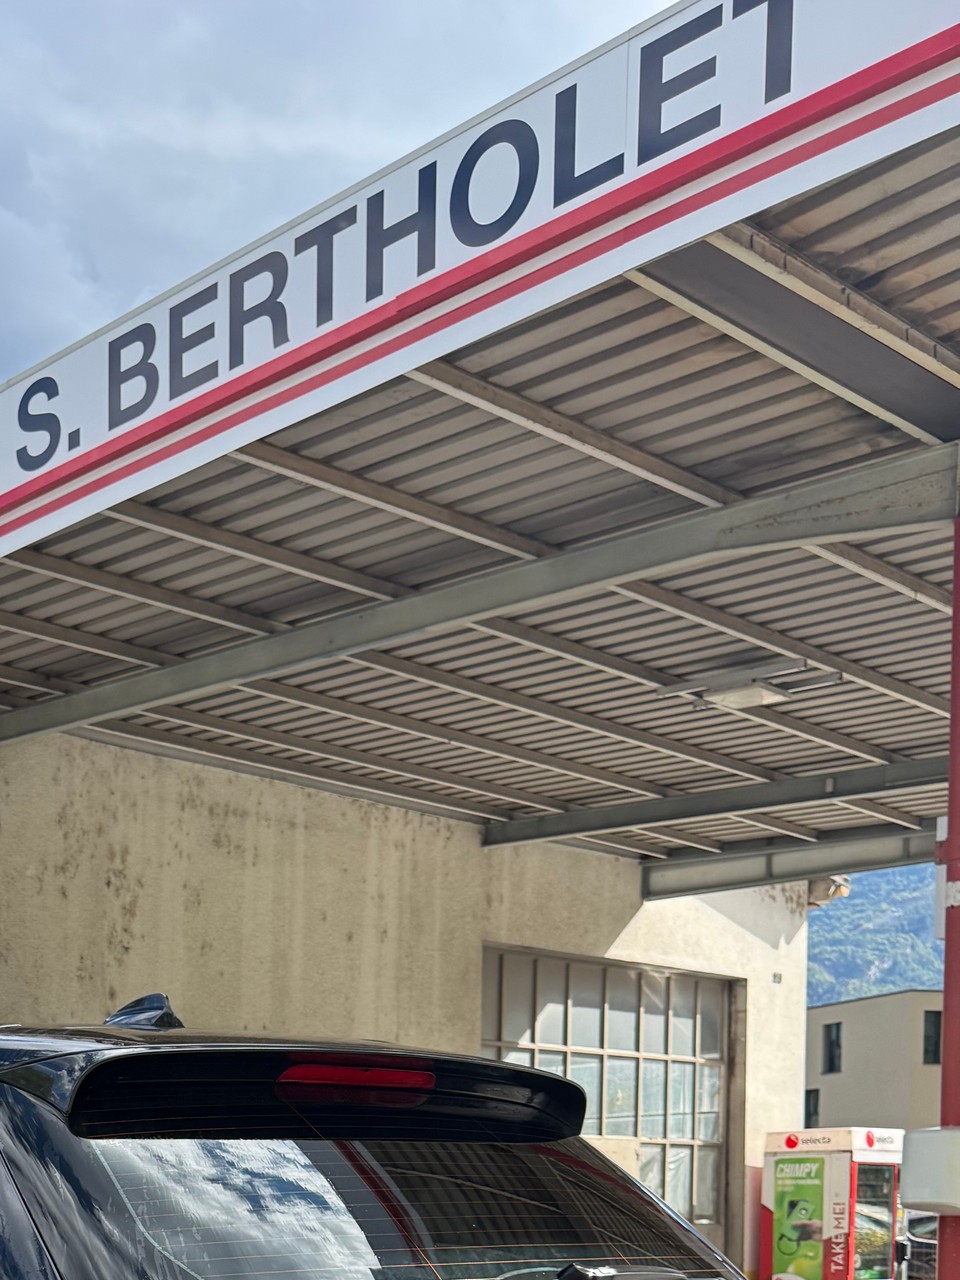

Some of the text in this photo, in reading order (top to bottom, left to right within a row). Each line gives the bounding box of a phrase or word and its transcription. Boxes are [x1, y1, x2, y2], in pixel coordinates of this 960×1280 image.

[16, 376, 80, 472] S.
[108, 0, 794, 430] BERTHOLET
[776, 1162, 820, 1177] CHIMPY
[831, 1234, 845, 1273] TAKE
